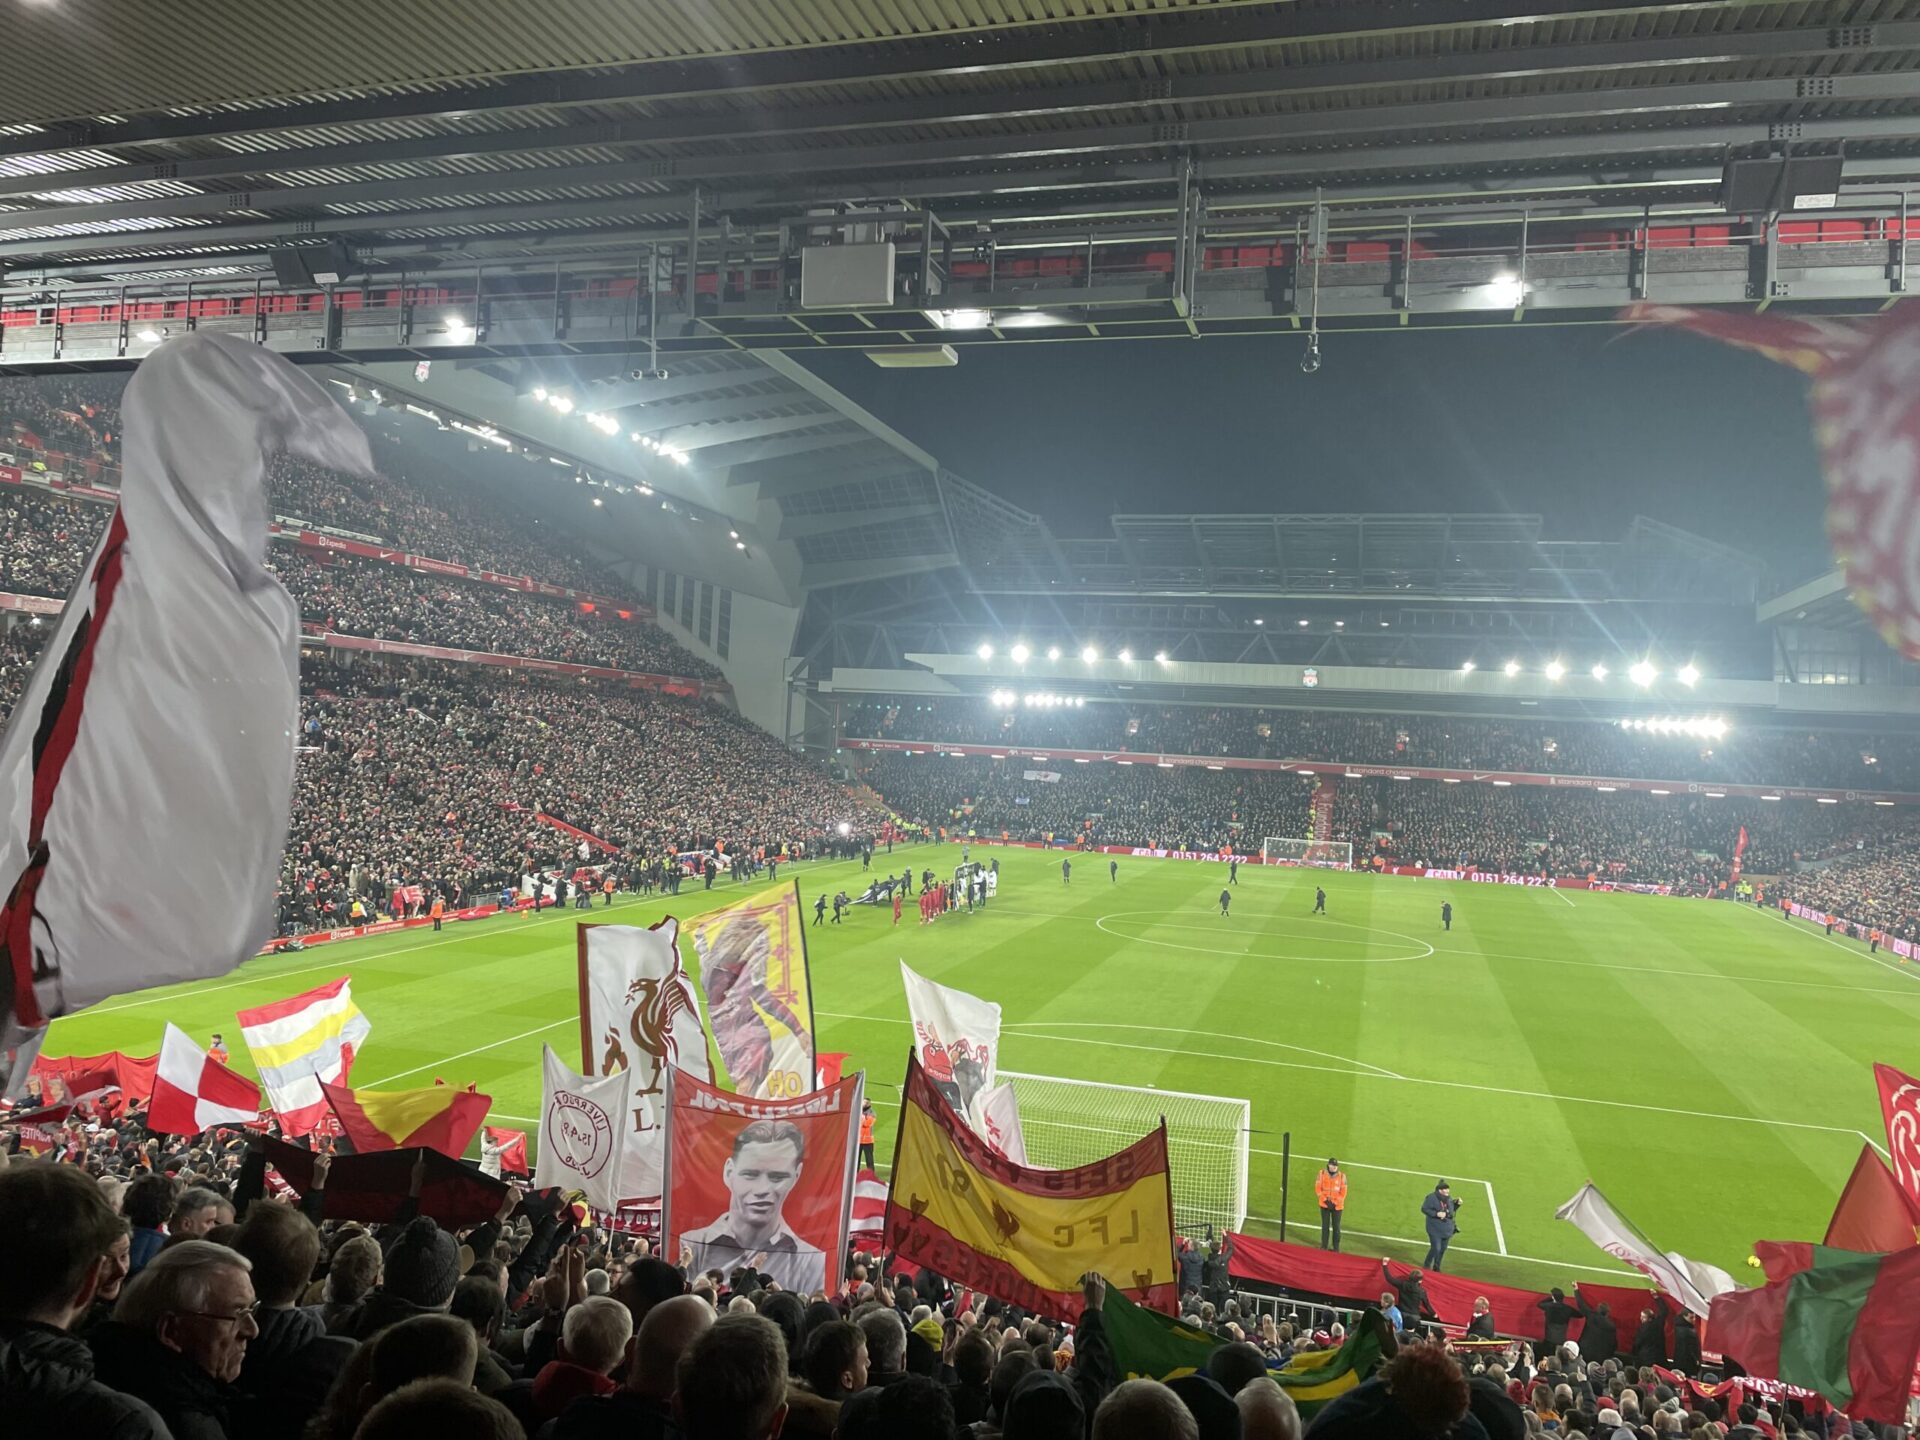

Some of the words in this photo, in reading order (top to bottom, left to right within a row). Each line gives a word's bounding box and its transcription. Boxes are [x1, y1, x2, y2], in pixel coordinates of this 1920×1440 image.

[326, 539, 347, 550] Expedia
[1385, 769, 1420, 777] chartered
[1172, 851, 1197, 860] 0151
[1200, 853, 1219, 862] 264
[1221, 854, 1248, 864] 2222
[1471, 872, 1499, 883] 0151
[1502, 875, 1524, 885] 264
